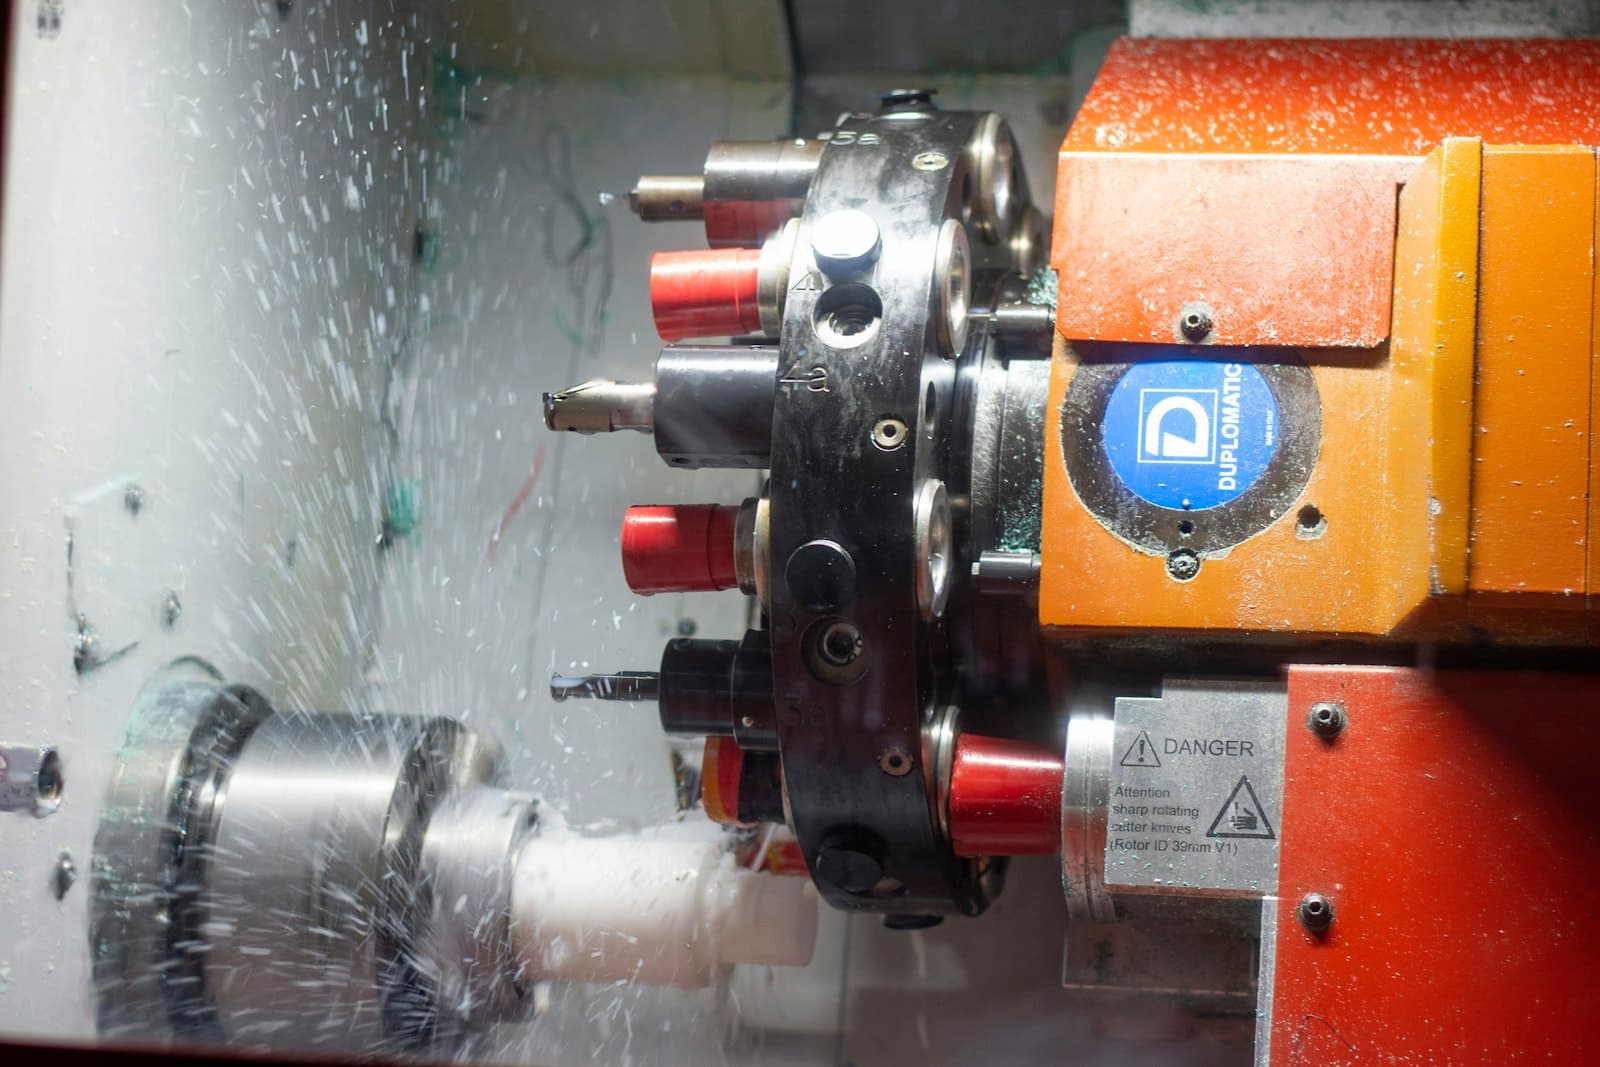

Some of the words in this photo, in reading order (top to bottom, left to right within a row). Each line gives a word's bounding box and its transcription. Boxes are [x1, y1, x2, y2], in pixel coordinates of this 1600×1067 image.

[830, 131, 880, 145] 5a
[779, 360, 830, 393] 4a
[1218, 363, 1242, 491] DUPLOMATIC
[1163, 738, 1254, 757] DANGER
[1114, 786, 1170, 799] Attention
[1112, 804, 1149, 818] sharp
[1152, 806, 1200, 819] rotating
[1151, 823, 1192, 835] knives
[1110, 839, 1150, 852] (Rotor
[1154, 840, 1168, 851] ID
[1172, 841, 1211, 853] 39mm
[1215, 842, 1238, 855] V1)
